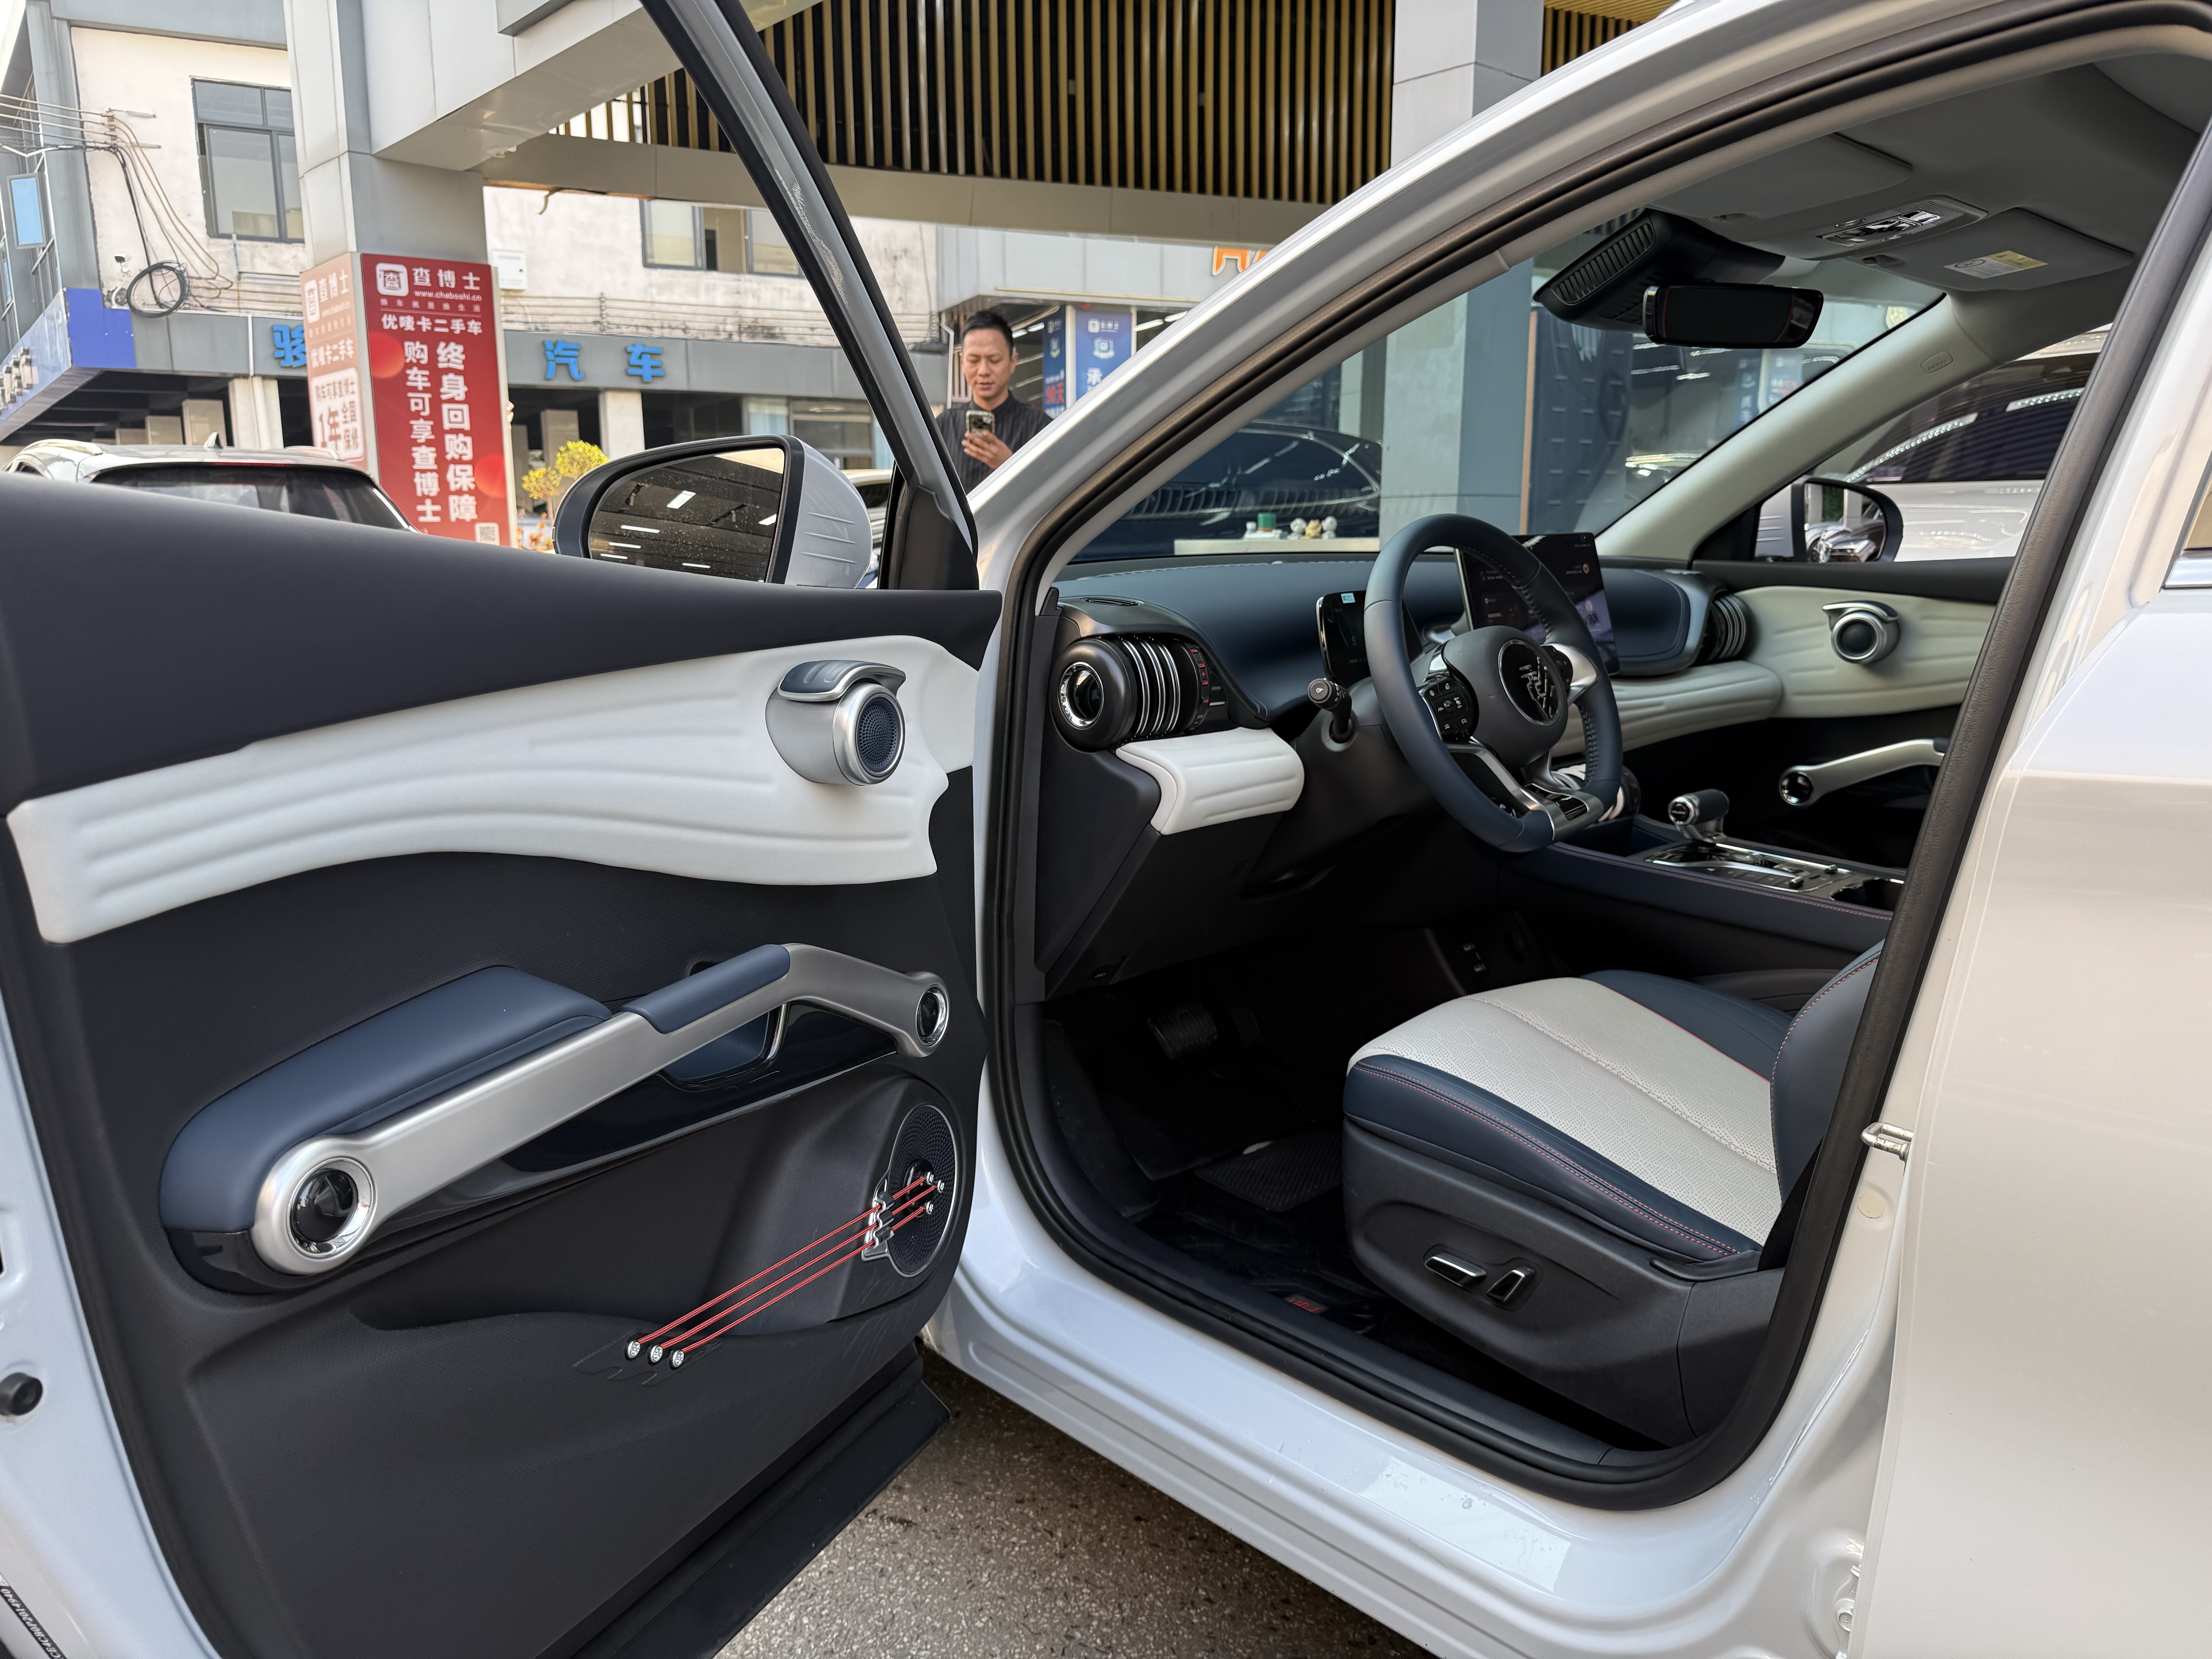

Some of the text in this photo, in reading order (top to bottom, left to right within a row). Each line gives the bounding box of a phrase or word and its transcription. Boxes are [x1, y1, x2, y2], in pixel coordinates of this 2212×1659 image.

[318, 269, 349, 302] 查博士
[412, 267, 480, 290] 查博士
[381, 313, 483, 335] 优唛卡二手车
[543, 340, 665, 383] 汽车
[319, 405, 342, 451] 1年
[404, 340, 442, 523] 购车可享查博士
[436, 341, 478, 522] 终身回购保障
[0, 1589, 63, 1659] CE4CB0P2014940
